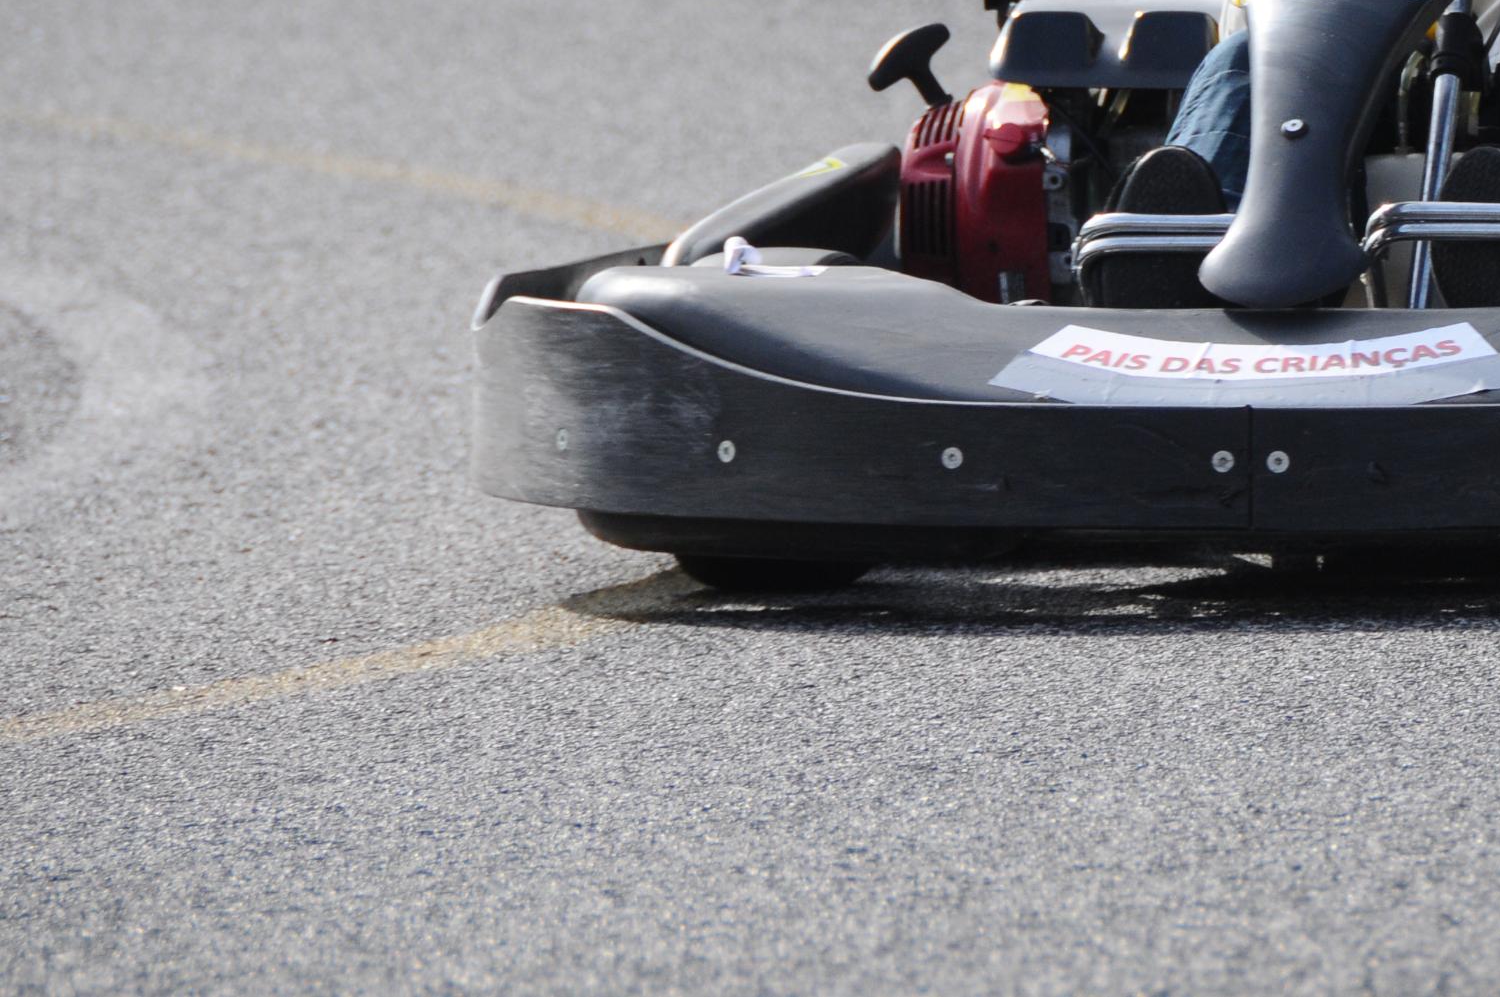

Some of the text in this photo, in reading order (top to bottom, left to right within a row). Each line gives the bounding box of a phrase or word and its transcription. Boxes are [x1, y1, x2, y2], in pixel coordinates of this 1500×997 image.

[1060, 339, 1462, 374] PAIS DAS CRIANÇAS
